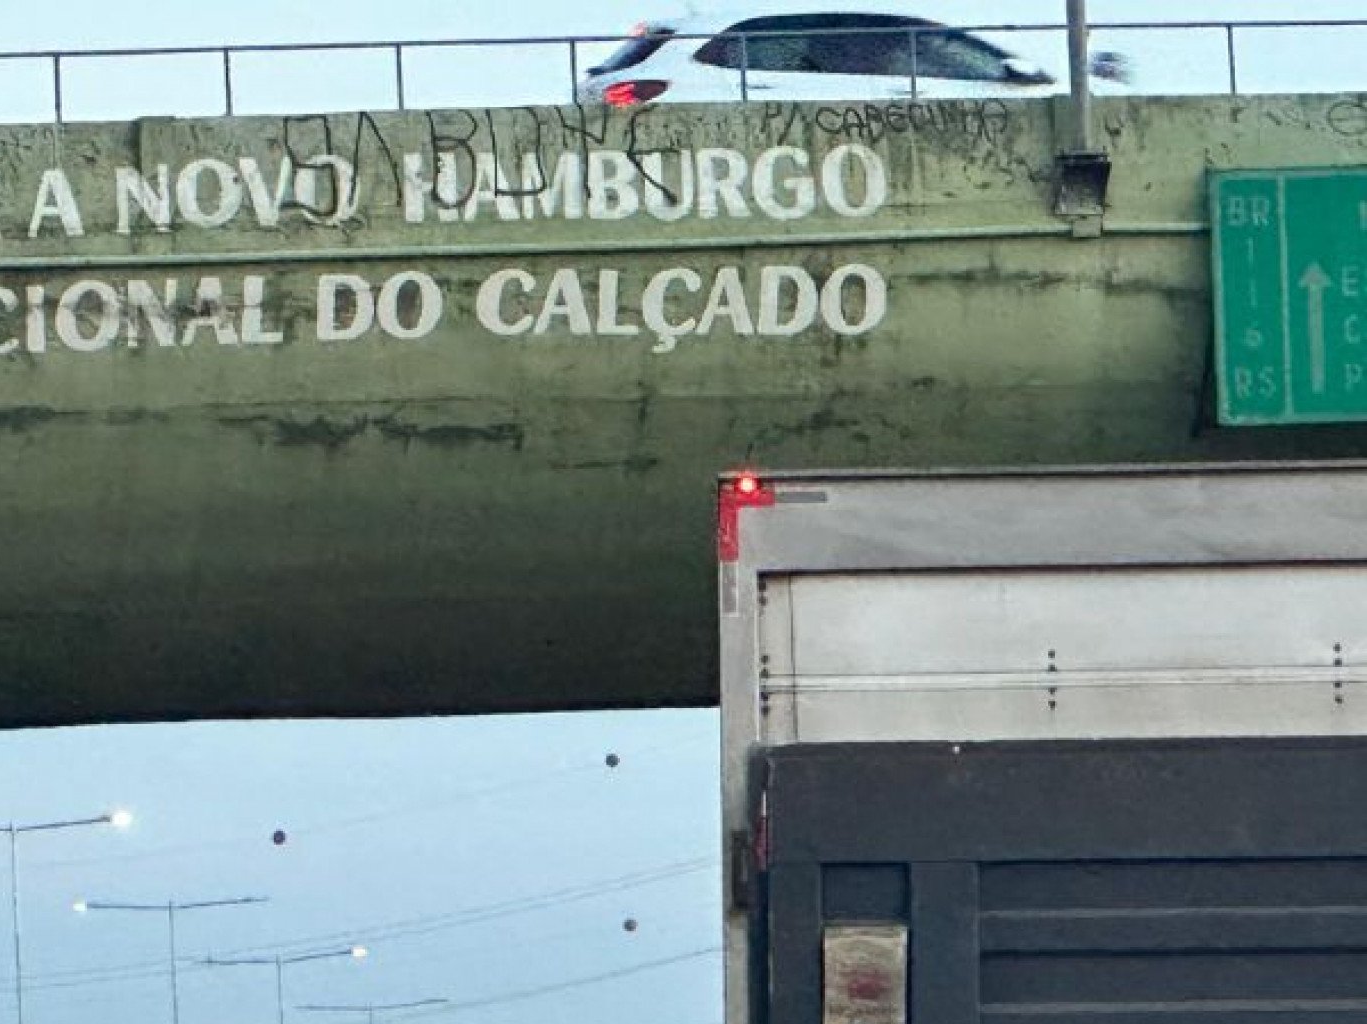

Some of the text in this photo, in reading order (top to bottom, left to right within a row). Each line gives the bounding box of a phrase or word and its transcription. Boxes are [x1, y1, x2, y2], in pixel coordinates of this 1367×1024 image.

[29, 168, 85, 238] A
[115, 153, 361, 234] NOVO
[403, 143, 888, 226] HAMBURGO
[1225, 196, 1271, 226] BR
[317, 270, 446, 342] DO
[475, 263, 889, 354] CALÇADO
[1236, 366, 1277, 398] RS
